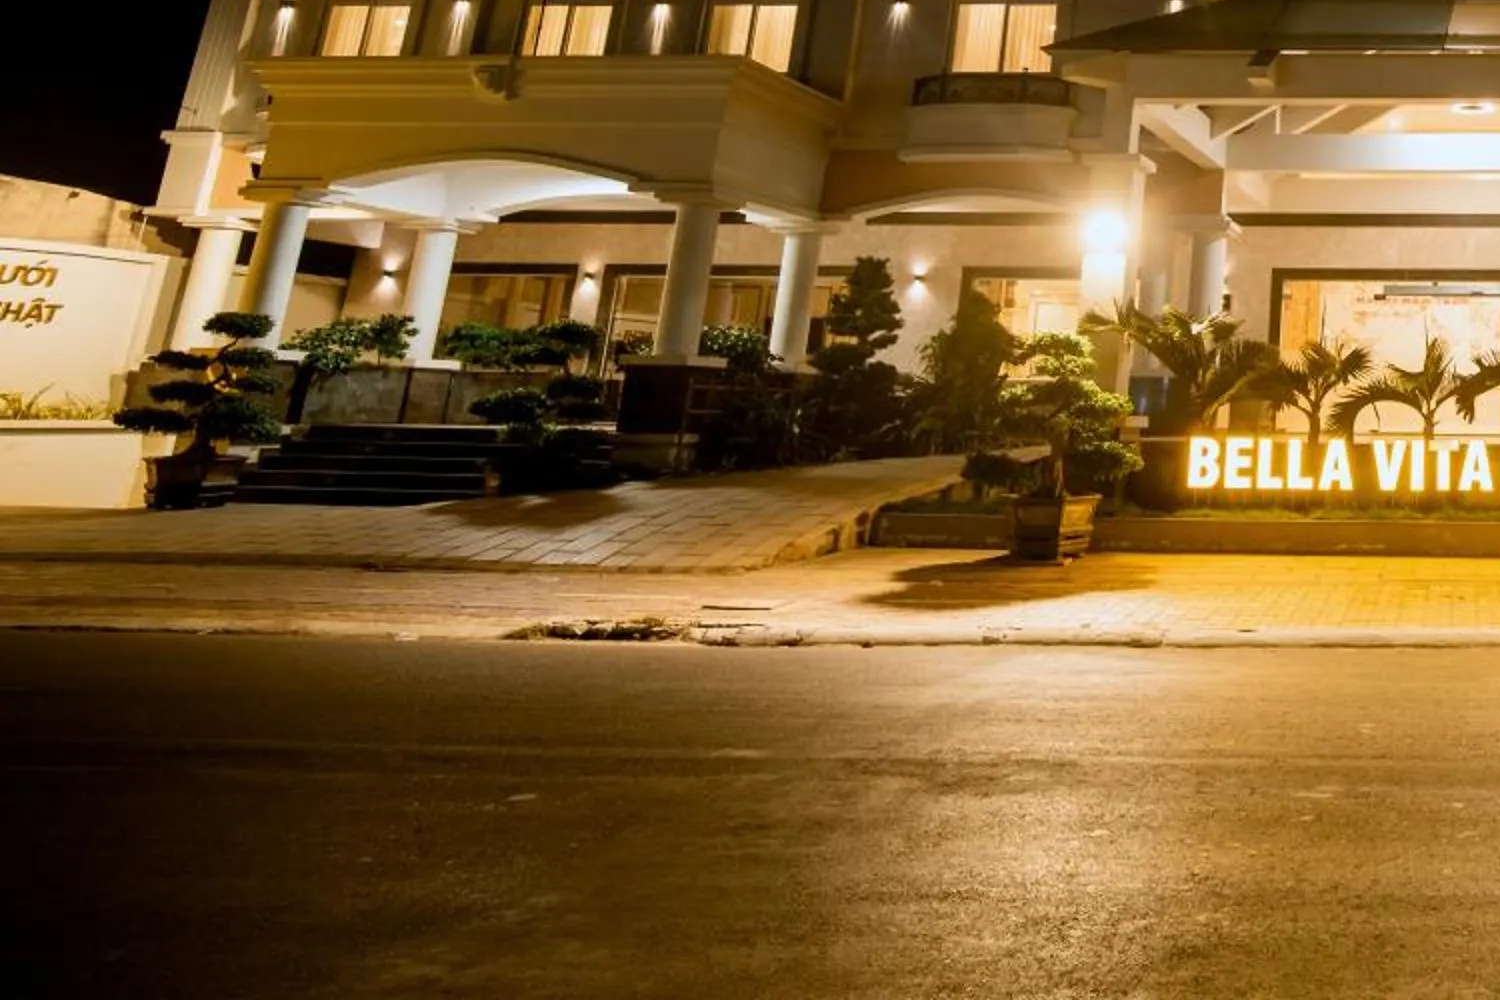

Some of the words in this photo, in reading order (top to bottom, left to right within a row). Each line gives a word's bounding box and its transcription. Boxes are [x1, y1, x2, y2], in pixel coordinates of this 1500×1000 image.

[0, 297, 65, 328] HẬT
[1187, 437, 1354, 490] BELLA
[1372, 439, 1494, 491] VITA
